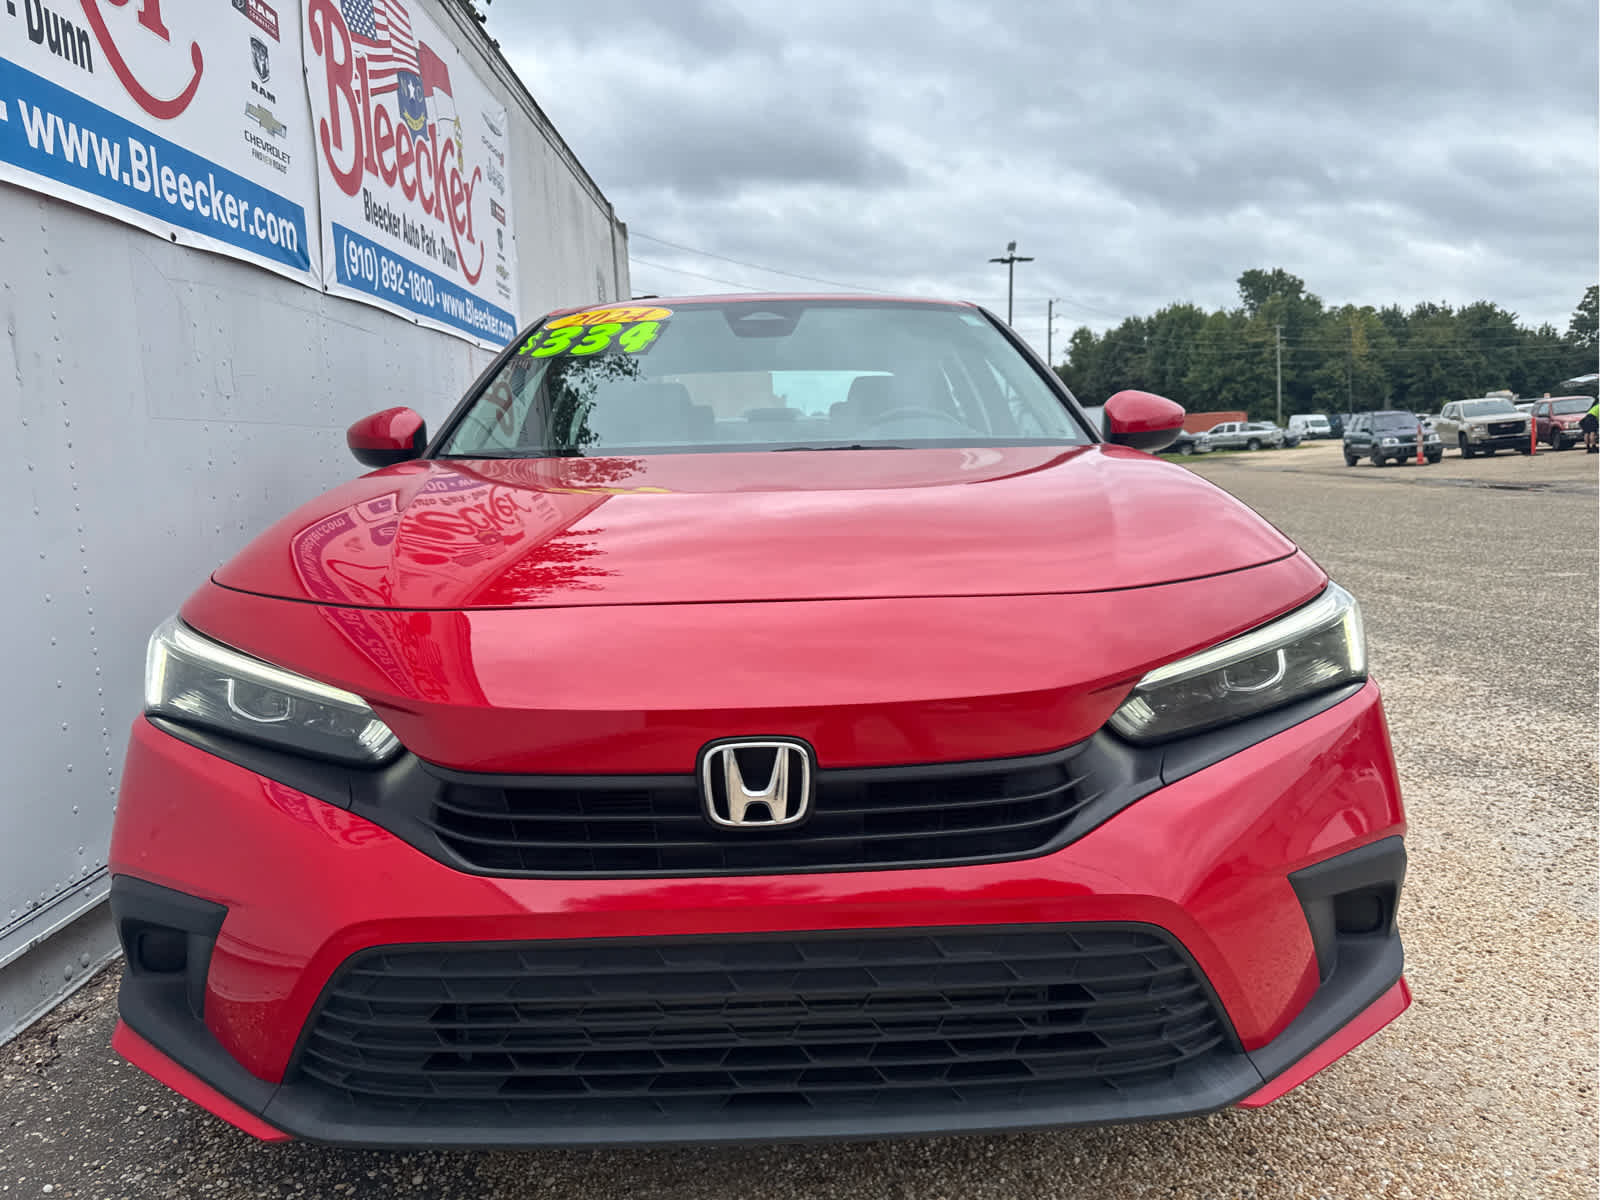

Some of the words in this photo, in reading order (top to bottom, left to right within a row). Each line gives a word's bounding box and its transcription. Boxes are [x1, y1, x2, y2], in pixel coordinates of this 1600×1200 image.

[24, 0, 94, 74] Dunn
[251, 80, 276, 105] RAM
[18, 98, 299, 254] www.Bleecker.com
[244, 129, 291, 163] CHEVROLET
[308, 0, 484, 286] Bleecker
[363, 188, 401, 239] Bleecker
[402, 213, 421, 252] Auto
[420, 224, 438, 261] Park
[441, 237, 458, 272] Dunn
[343, 234, 379, 291] (910)
[381, 256, 436, 308] 892-1800
[441, 290, 515, 341] www.Bleecker.com
[517, 320, 661, 358] $334
